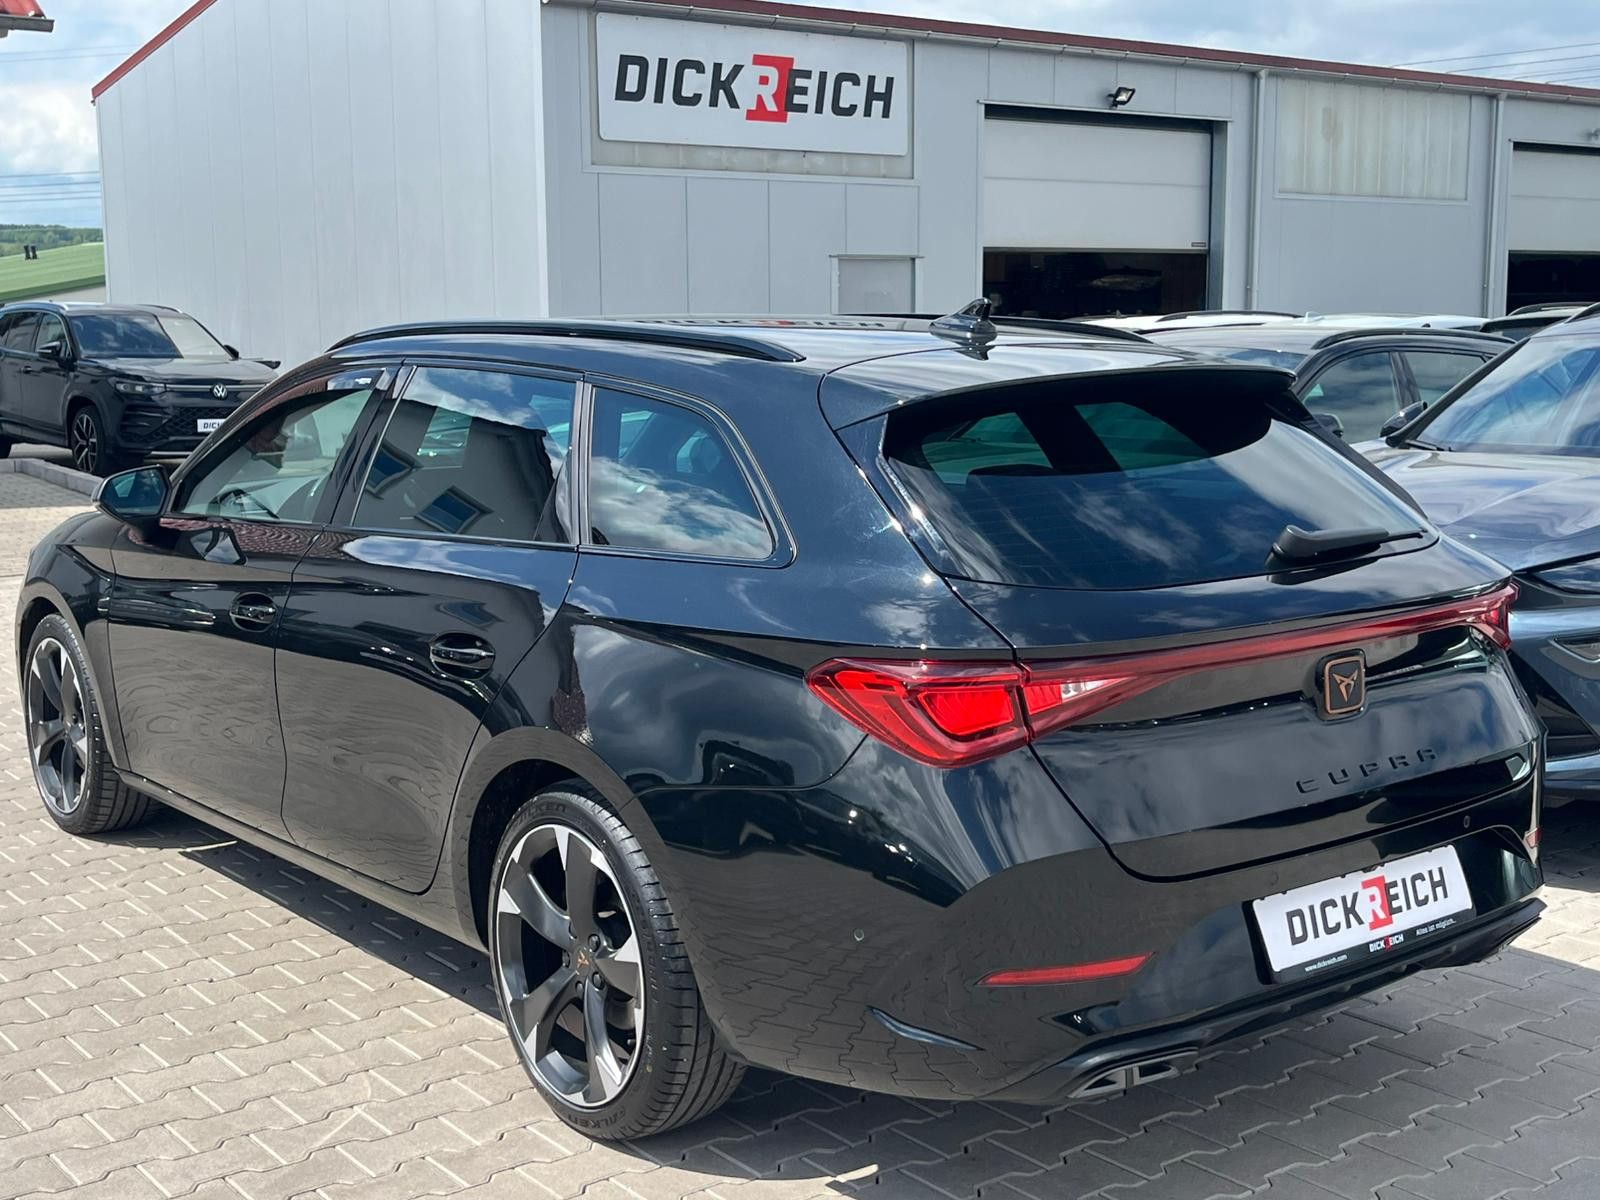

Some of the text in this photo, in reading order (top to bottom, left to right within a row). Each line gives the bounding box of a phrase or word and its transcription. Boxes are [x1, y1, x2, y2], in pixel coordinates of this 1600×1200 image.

[614, 54, 895, 123] DICKREICH
[1295, 748, 1437, 794] CUPRA
[1285, 866, 1449, 946] DICKREICH
